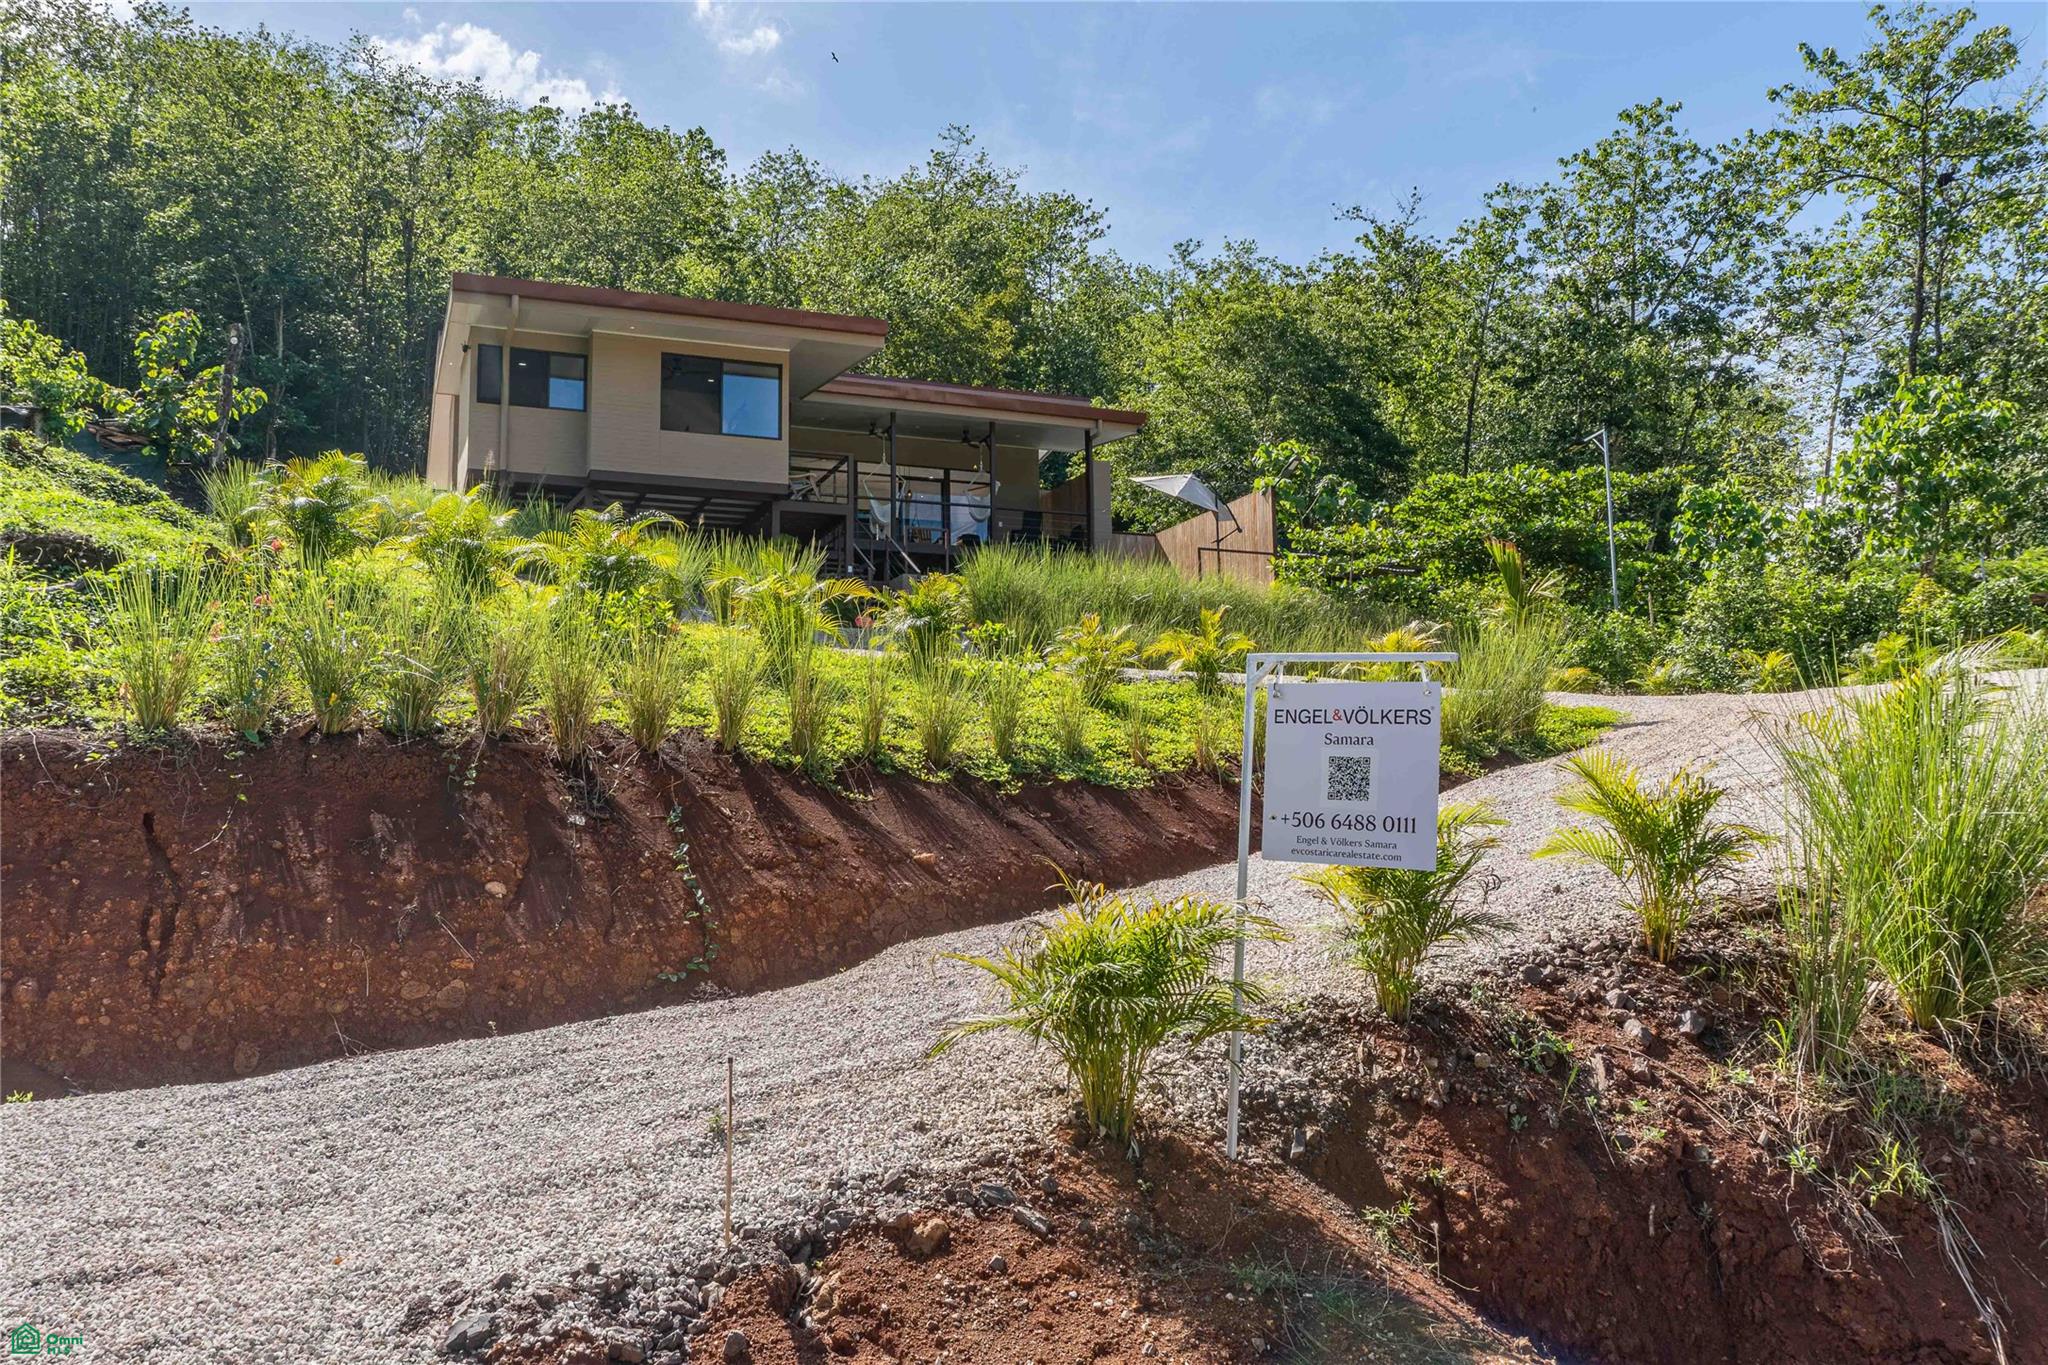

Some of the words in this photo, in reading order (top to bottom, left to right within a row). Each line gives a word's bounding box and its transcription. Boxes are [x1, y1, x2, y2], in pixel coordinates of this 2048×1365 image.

[1274, 706, 1432, 725] ENGEL&VÖLKERS
[1324, 732, 1374, 746] Samara
[1281, 811, 1325, 829] +506
[1331, 813, 1377, 832] 6488
[1383, 815, 1416, 834] 0111
[1296, 835, 1319, 846] Engel
[1321, 837, 1328, 846] &
[1329, 836, 1363, 848] Völkers
[1364, 839, 1397, 850] Samara
[1291, 847, 1402, 862] evcostaricarealestate.com
